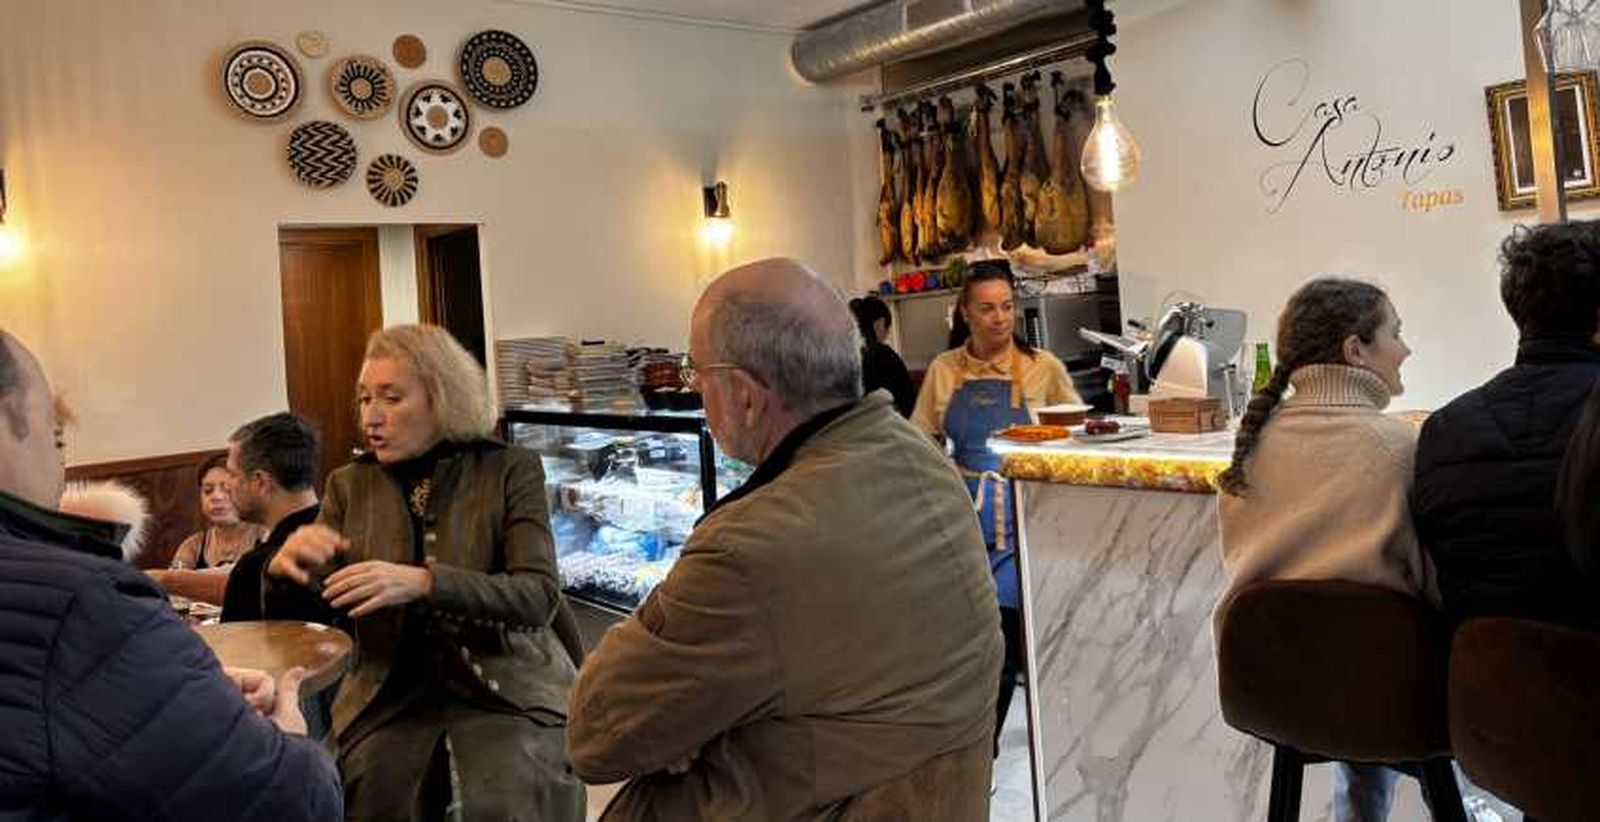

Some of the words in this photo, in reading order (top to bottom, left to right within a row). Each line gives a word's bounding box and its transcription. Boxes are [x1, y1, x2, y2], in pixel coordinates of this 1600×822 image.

[1252, 58, 1360, 147] Casa
[1260, 113, 1455, 214] Antonio
[1398, 186, 1465, 213] Tapas
